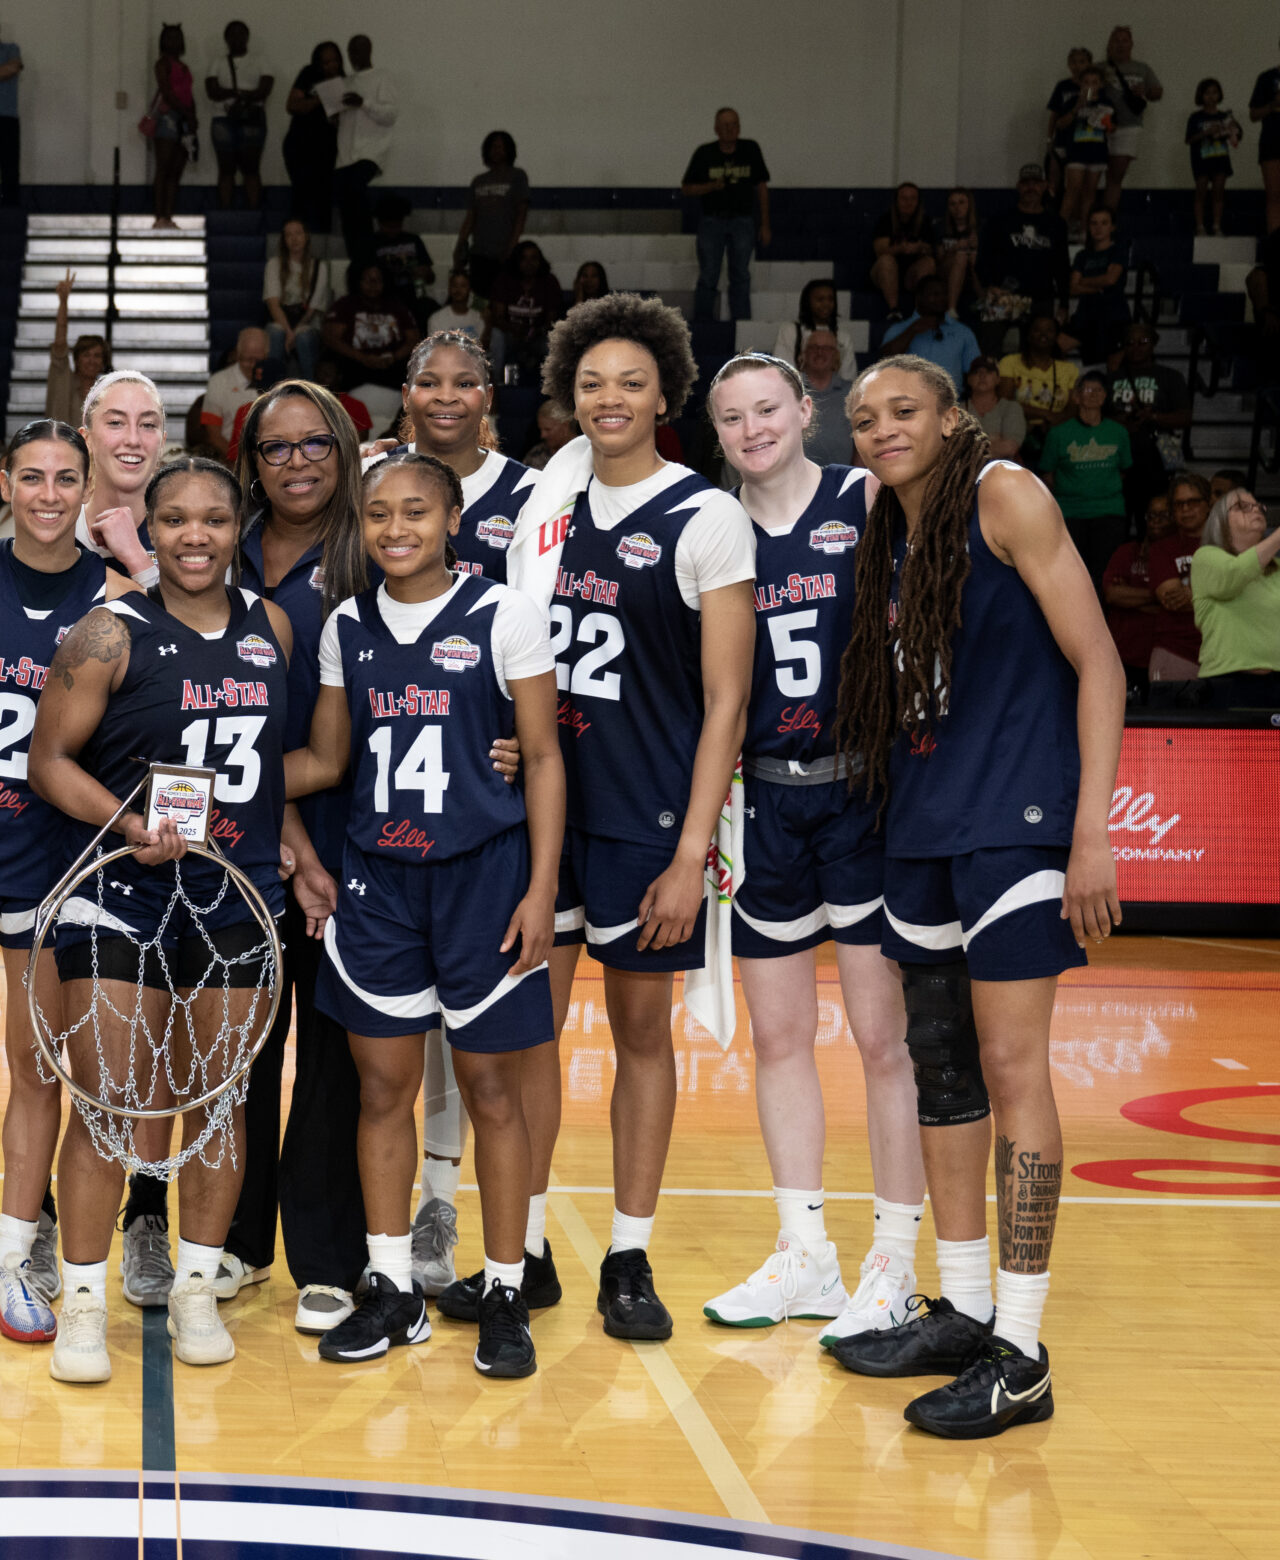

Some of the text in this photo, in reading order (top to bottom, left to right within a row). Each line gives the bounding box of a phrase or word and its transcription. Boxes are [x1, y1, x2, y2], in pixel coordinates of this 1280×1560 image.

[549, 604, 626, 701] 22
[767, 608, 821, 698] 5
[777, 702, 823, 738] Lilly
[180, 715, 268, 803] 13
[368, 725, 451, 814] 14
[178, 827, 197, 836] 2025
[1108, 786, 1181, 845] lly
[377, 819, 435, 857] Lilly
[1018, 1151, 1062, 1181] Strong
[1031, 1152, 1041, 1161] BE
[1016, 1202, 1028, 1212] DO
[1014, 1224, 1034, 1240] FOR
[1034, 1225, 1049, 1241] THE
[1012, 1242, 1043, 1260] YOUR
